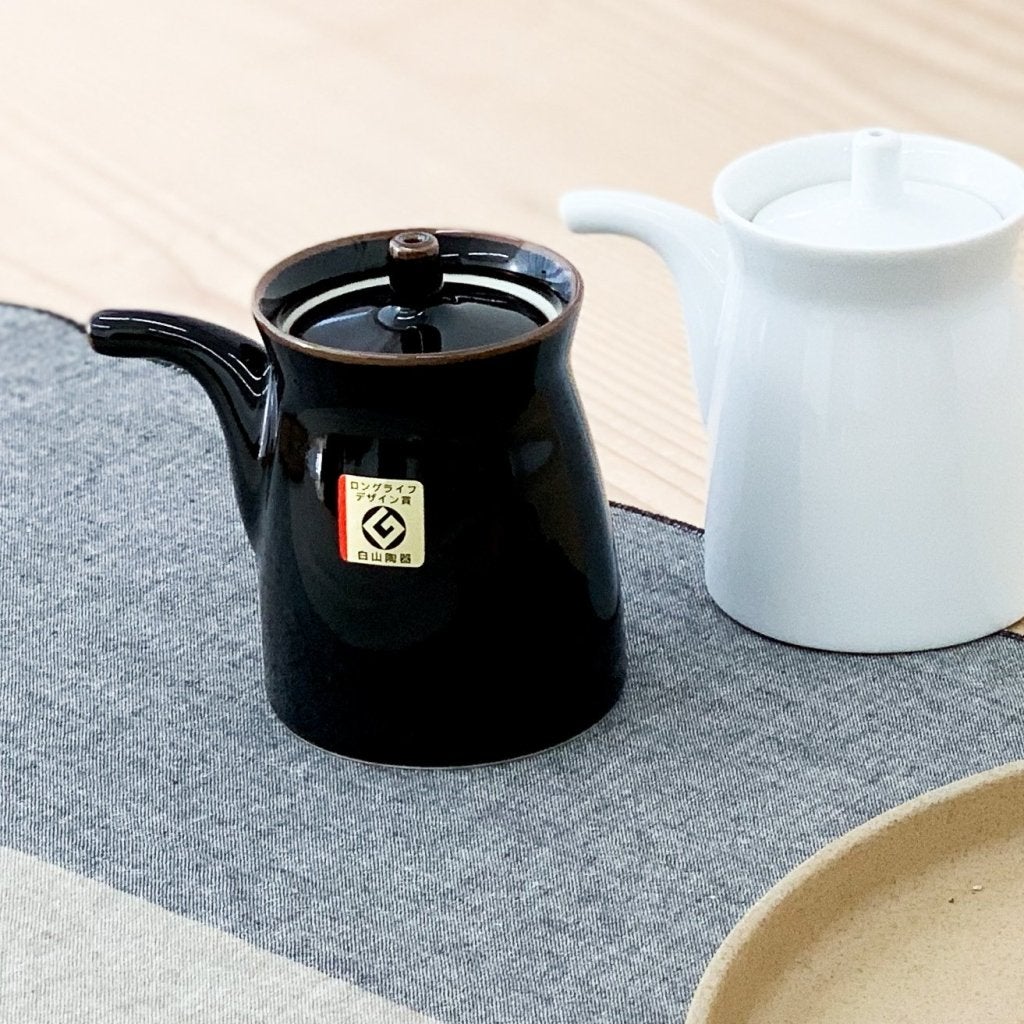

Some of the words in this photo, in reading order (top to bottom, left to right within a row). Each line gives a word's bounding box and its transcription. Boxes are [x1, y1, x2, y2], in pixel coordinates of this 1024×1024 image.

[350, 481, 417, 494] ロングライフ
[356, 492, 412, 505] デザイン賞
[358, 551, 411, 564] 白山陶器
